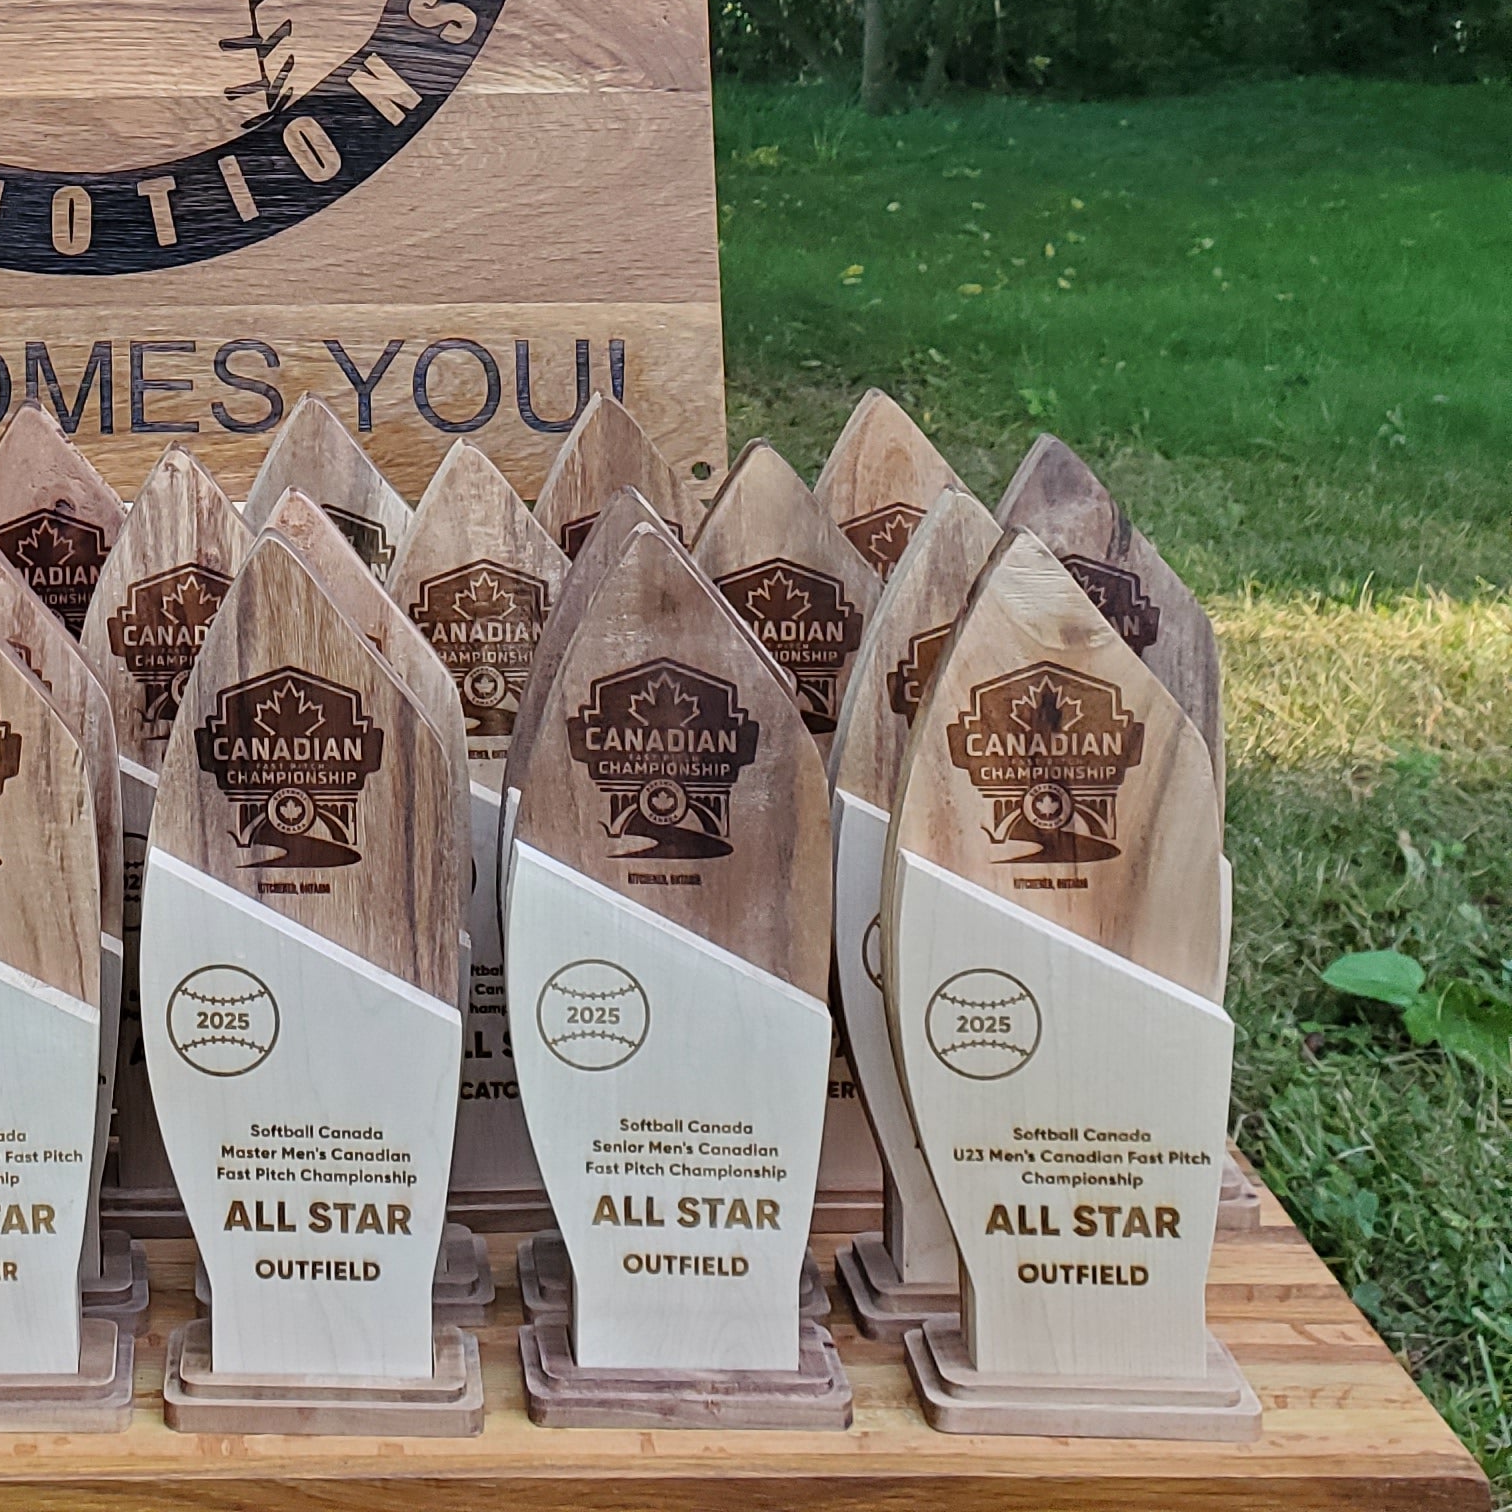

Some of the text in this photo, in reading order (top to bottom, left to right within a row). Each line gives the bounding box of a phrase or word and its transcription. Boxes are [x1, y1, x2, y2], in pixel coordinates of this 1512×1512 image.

[322, 338, 625, 433] YOU!
[123, 625, 208, 646] CANAD
[586, 727, 736, 752] CANADIAN
[967, 732, 1121, 756] CANADIAN
[214, 738, 362, 760] CANADIAN
[600, 760, 729, 776] CHAMPIONSHIP
[981, 764, 1116, 780] CHAMPIONSHIP
[228, 771, 356, 784] CHAMPIONSHIP
[197, 1012, 249, 1030] 2025
[567, 1006, 620, 1024] 2025
[956, 1016, 1011, 1033] 2025
[251, 1124, 383, 1140] Softball Canada
[620, 1118, 752, 1134] Softball Canada
[1014, 1128, 1151, 1142] Softball Canada
[6, 1151, 38, 1163] Fast
[44, 1150, 82, 1162] Pitch
[222, 1145, 410, 1162] Master Men's Canadian
[593, 1140, 778, 1157] Senior Men's Canadian
[954, 1148, 1210, 1164] U23 Men's Canadian Fast Pitch
[217, 1166, 417, 1188] Fast Pitch Championship
[586, 1161, 786, 1182] Fast Pitch Championship
[1022, 1171, 1143, 1189] Championship
[224, 1200, 411, 1235] ALL STAR
[592, 1195, 780, 1230] ALL STAR
[986, 1204, 1180, 1238] ALL STAR
[256, 1260, 380, 1281] OUTFIELD
[623, 1254, 748, 1276] OUTFIELD
[1018, 1264, 1148, 1286] OUTFIELD
